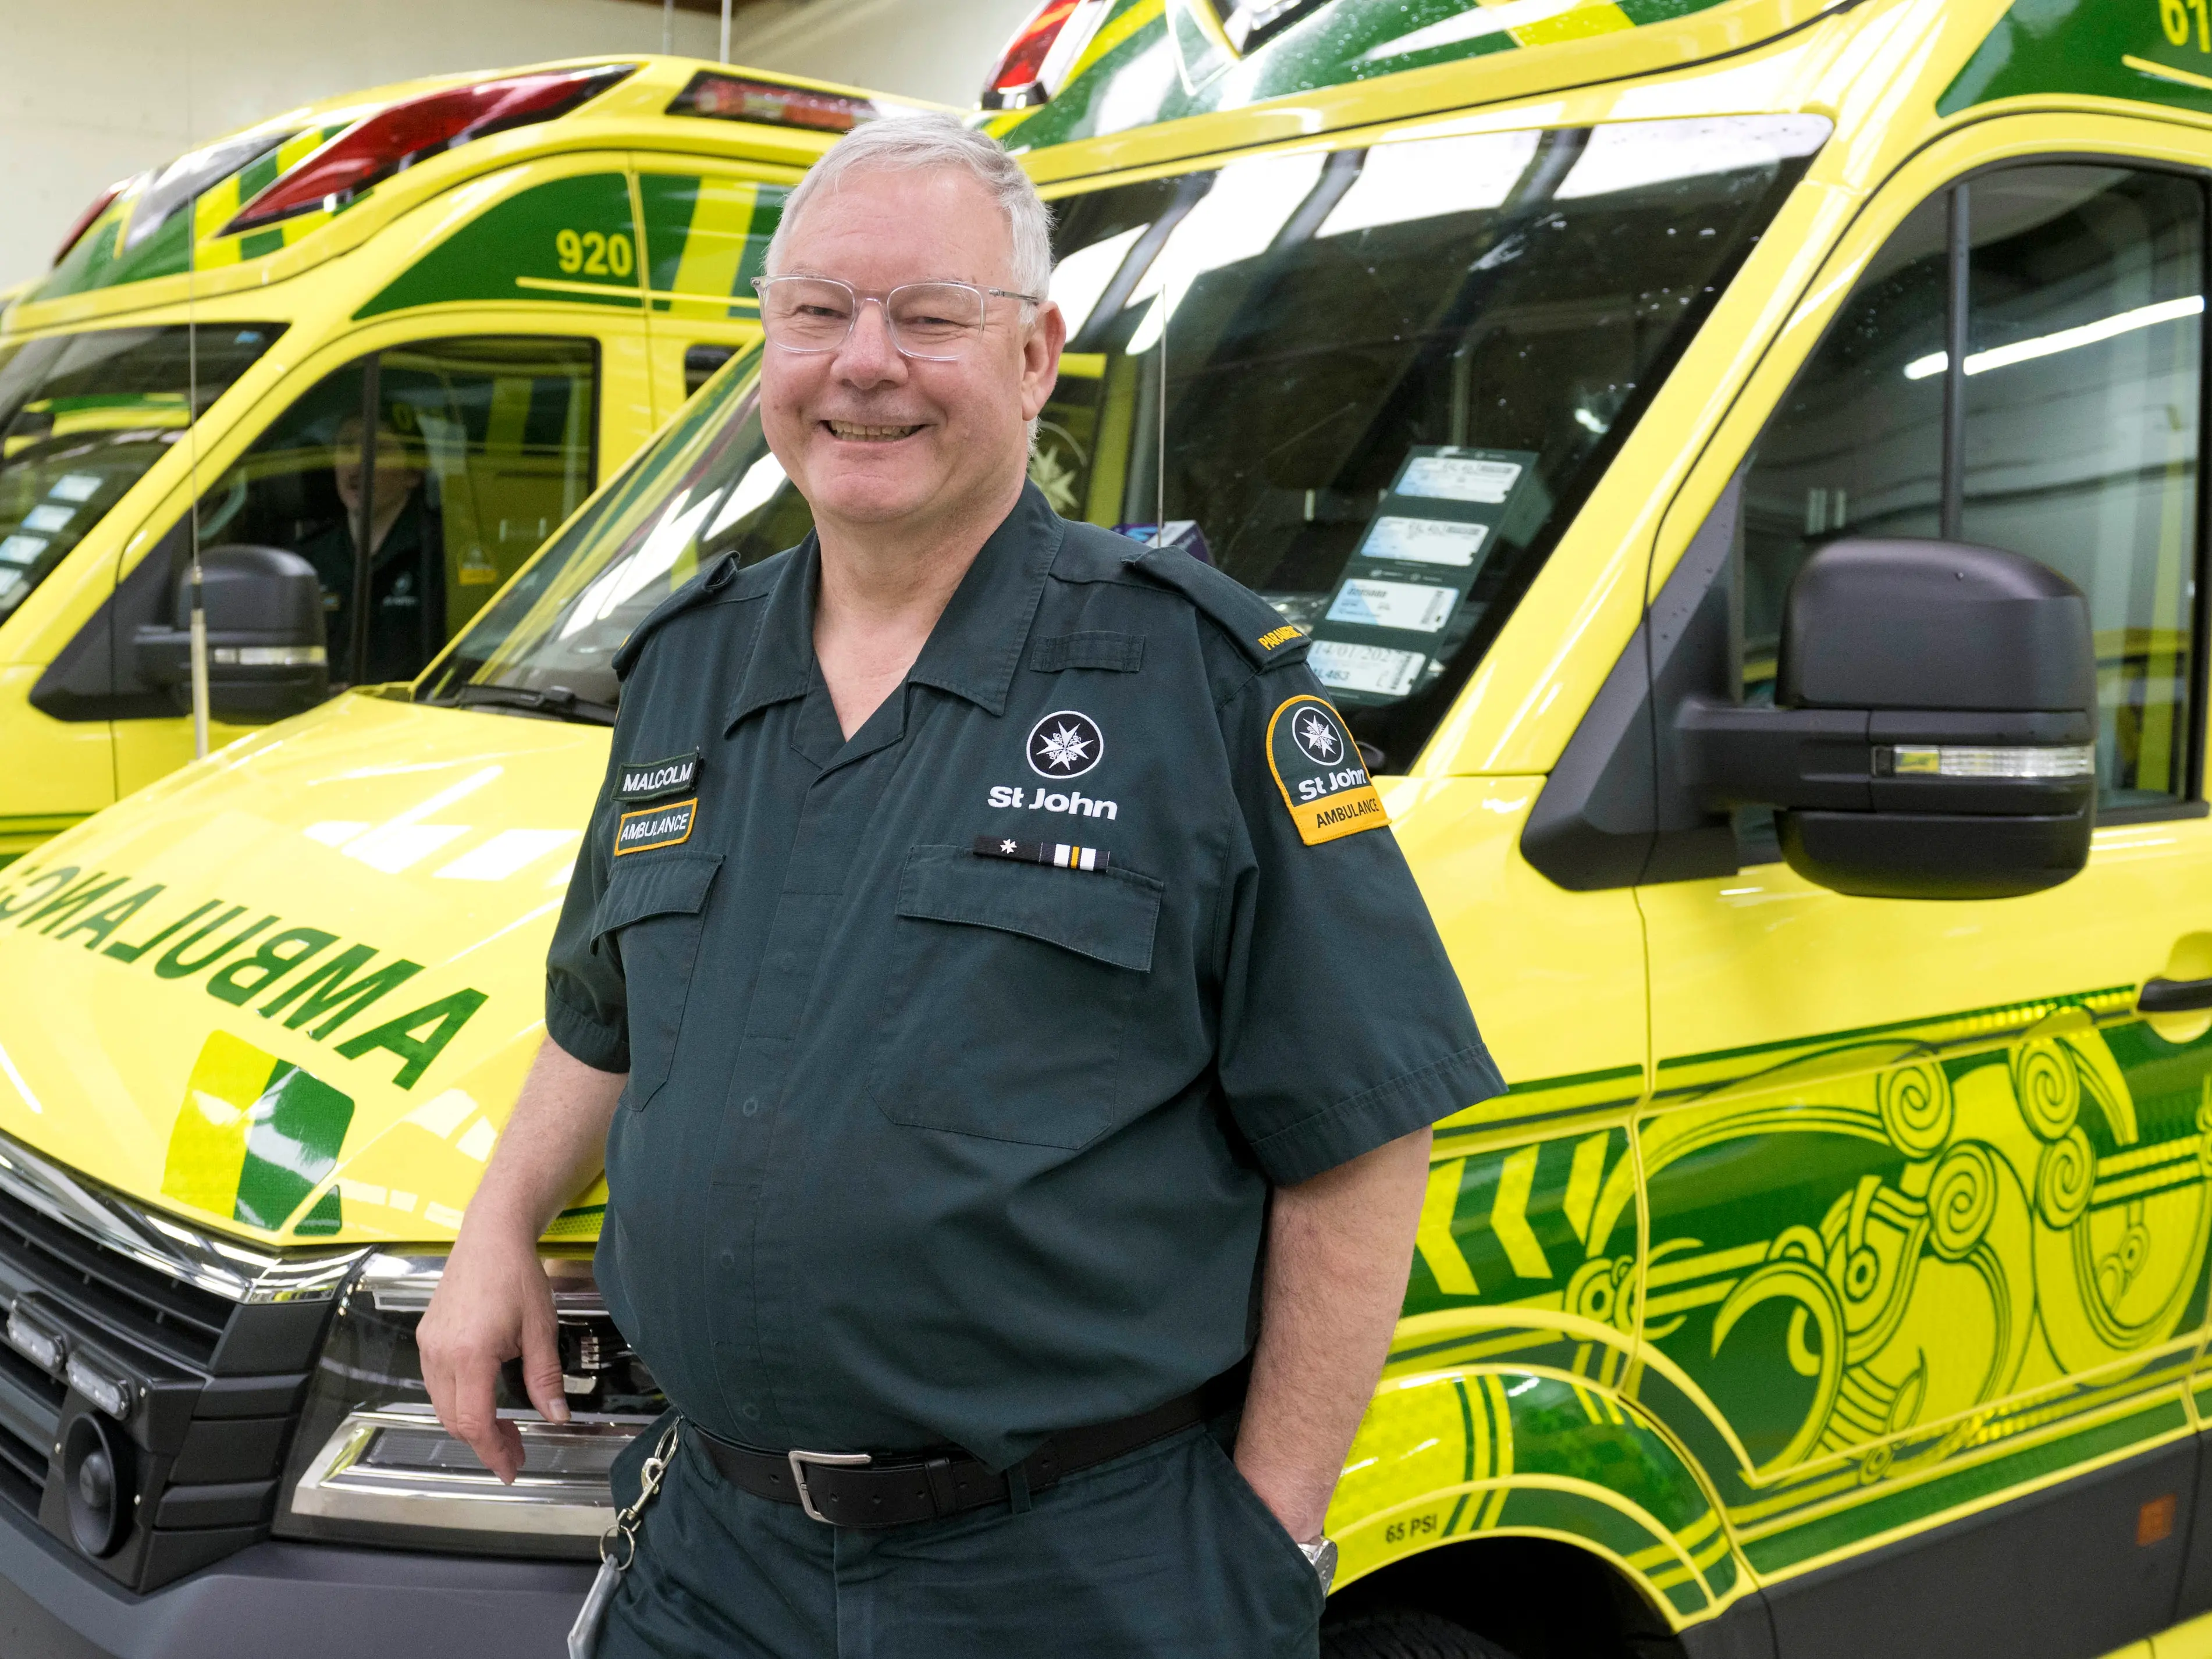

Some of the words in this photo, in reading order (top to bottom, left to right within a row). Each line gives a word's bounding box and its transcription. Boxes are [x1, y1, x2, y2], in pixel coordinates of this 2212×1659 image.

[556, 228, 633, 277] 920
[623, 762, 694, 792] MALCOLM
[1298, 777, 1327, 800] St
[1328, 768, 1367, 791] John
[987, 786, 1024, 808] St
[1029, 788, 1118, 820] John
[1316, 798, 1379, 828] AMBULANCE
[620, 813, 689, 842] AMBULANCE
[1385, 1522, 1406, 1544] 65
[1410, 1513, 1438, 1537] PSI
